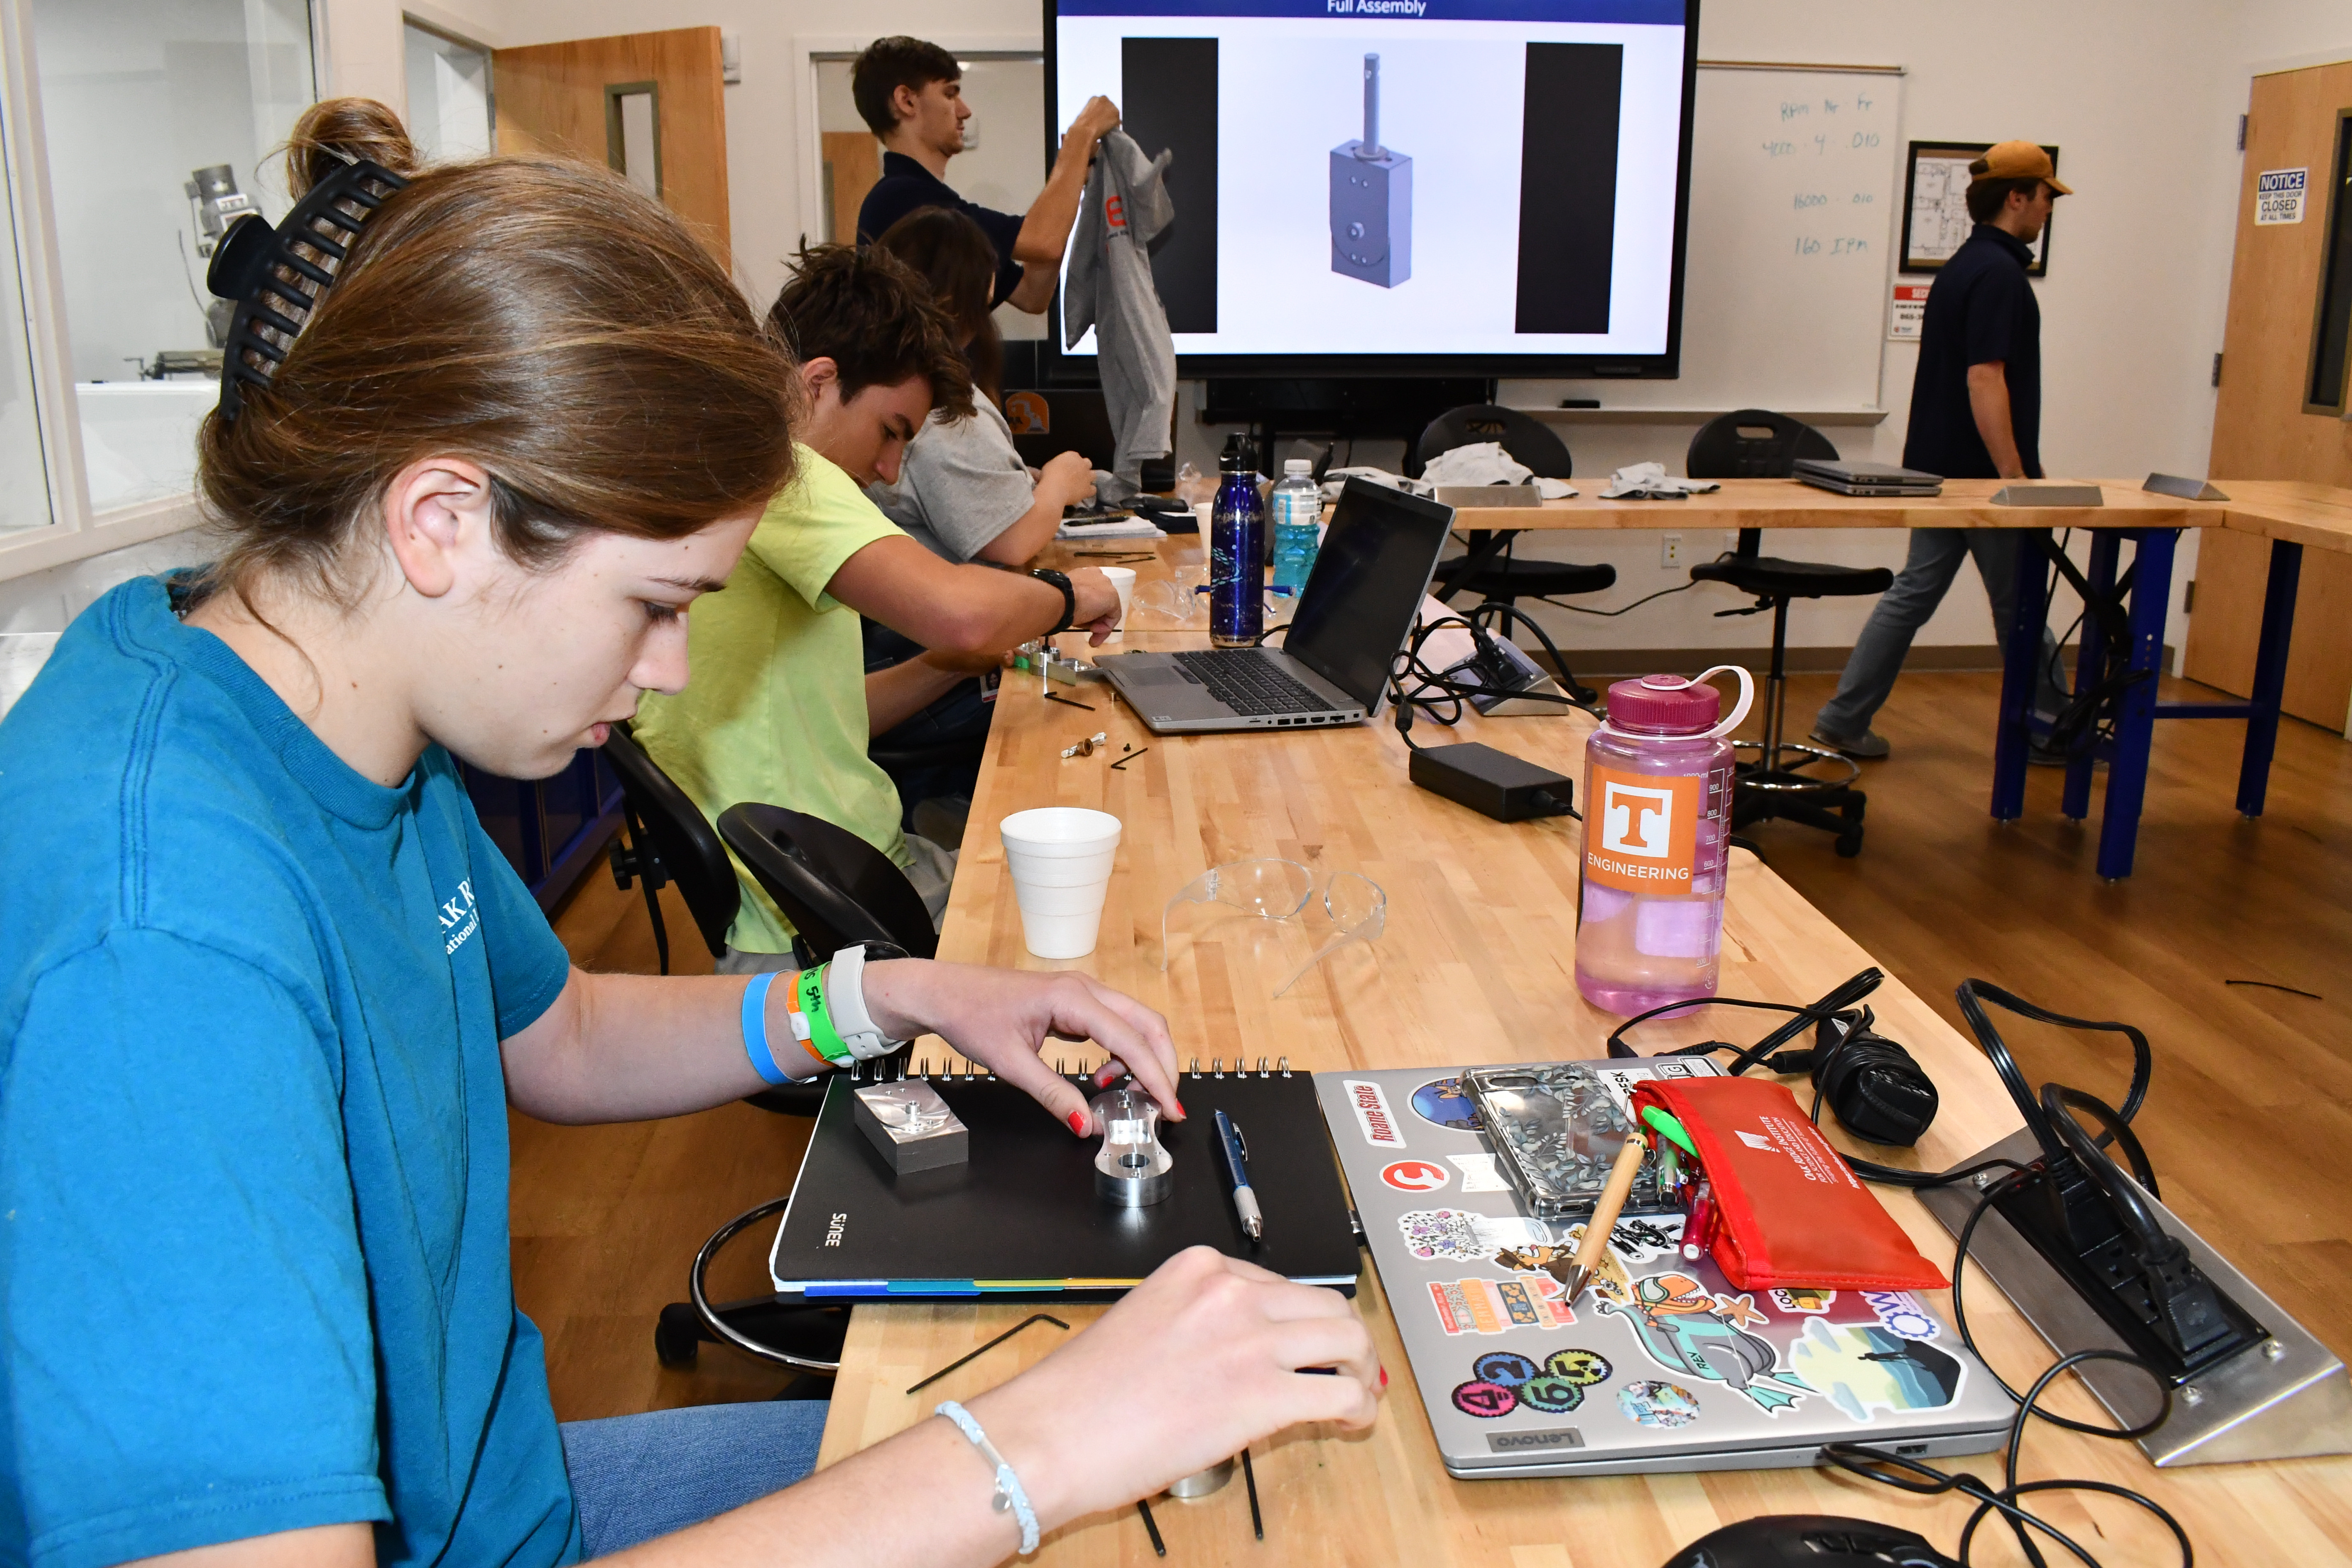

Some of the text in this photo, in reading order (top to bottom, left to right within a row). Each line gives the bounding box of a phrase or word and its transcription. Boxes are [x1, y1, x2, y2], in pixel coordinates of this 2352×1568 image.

[1327, 0, 1426, 17] Full Assembly
[2261, 173, 2303, 190] NOTICE
[2261, 199, 2297, 212] CLOSED
[1709, 783, 1719, 791] 900
[1612, 791, 1663, 848] T
[1707, 809, 1717, 817] 800
[1587, 852, 1689, 880] ENGINEERING
[446, 914, 477, 955] ational
[1354, 1085, 1396, 1142] Roane State
[1771, 1116, 1796, 1142] EDUCATION
[1759, 1115, 1816, 1181] OAK RIDGE INSTITUTE
[1686, 1351, 1710, 1369] REV
[1496, 1432, 1575, 1448] Lenovo
